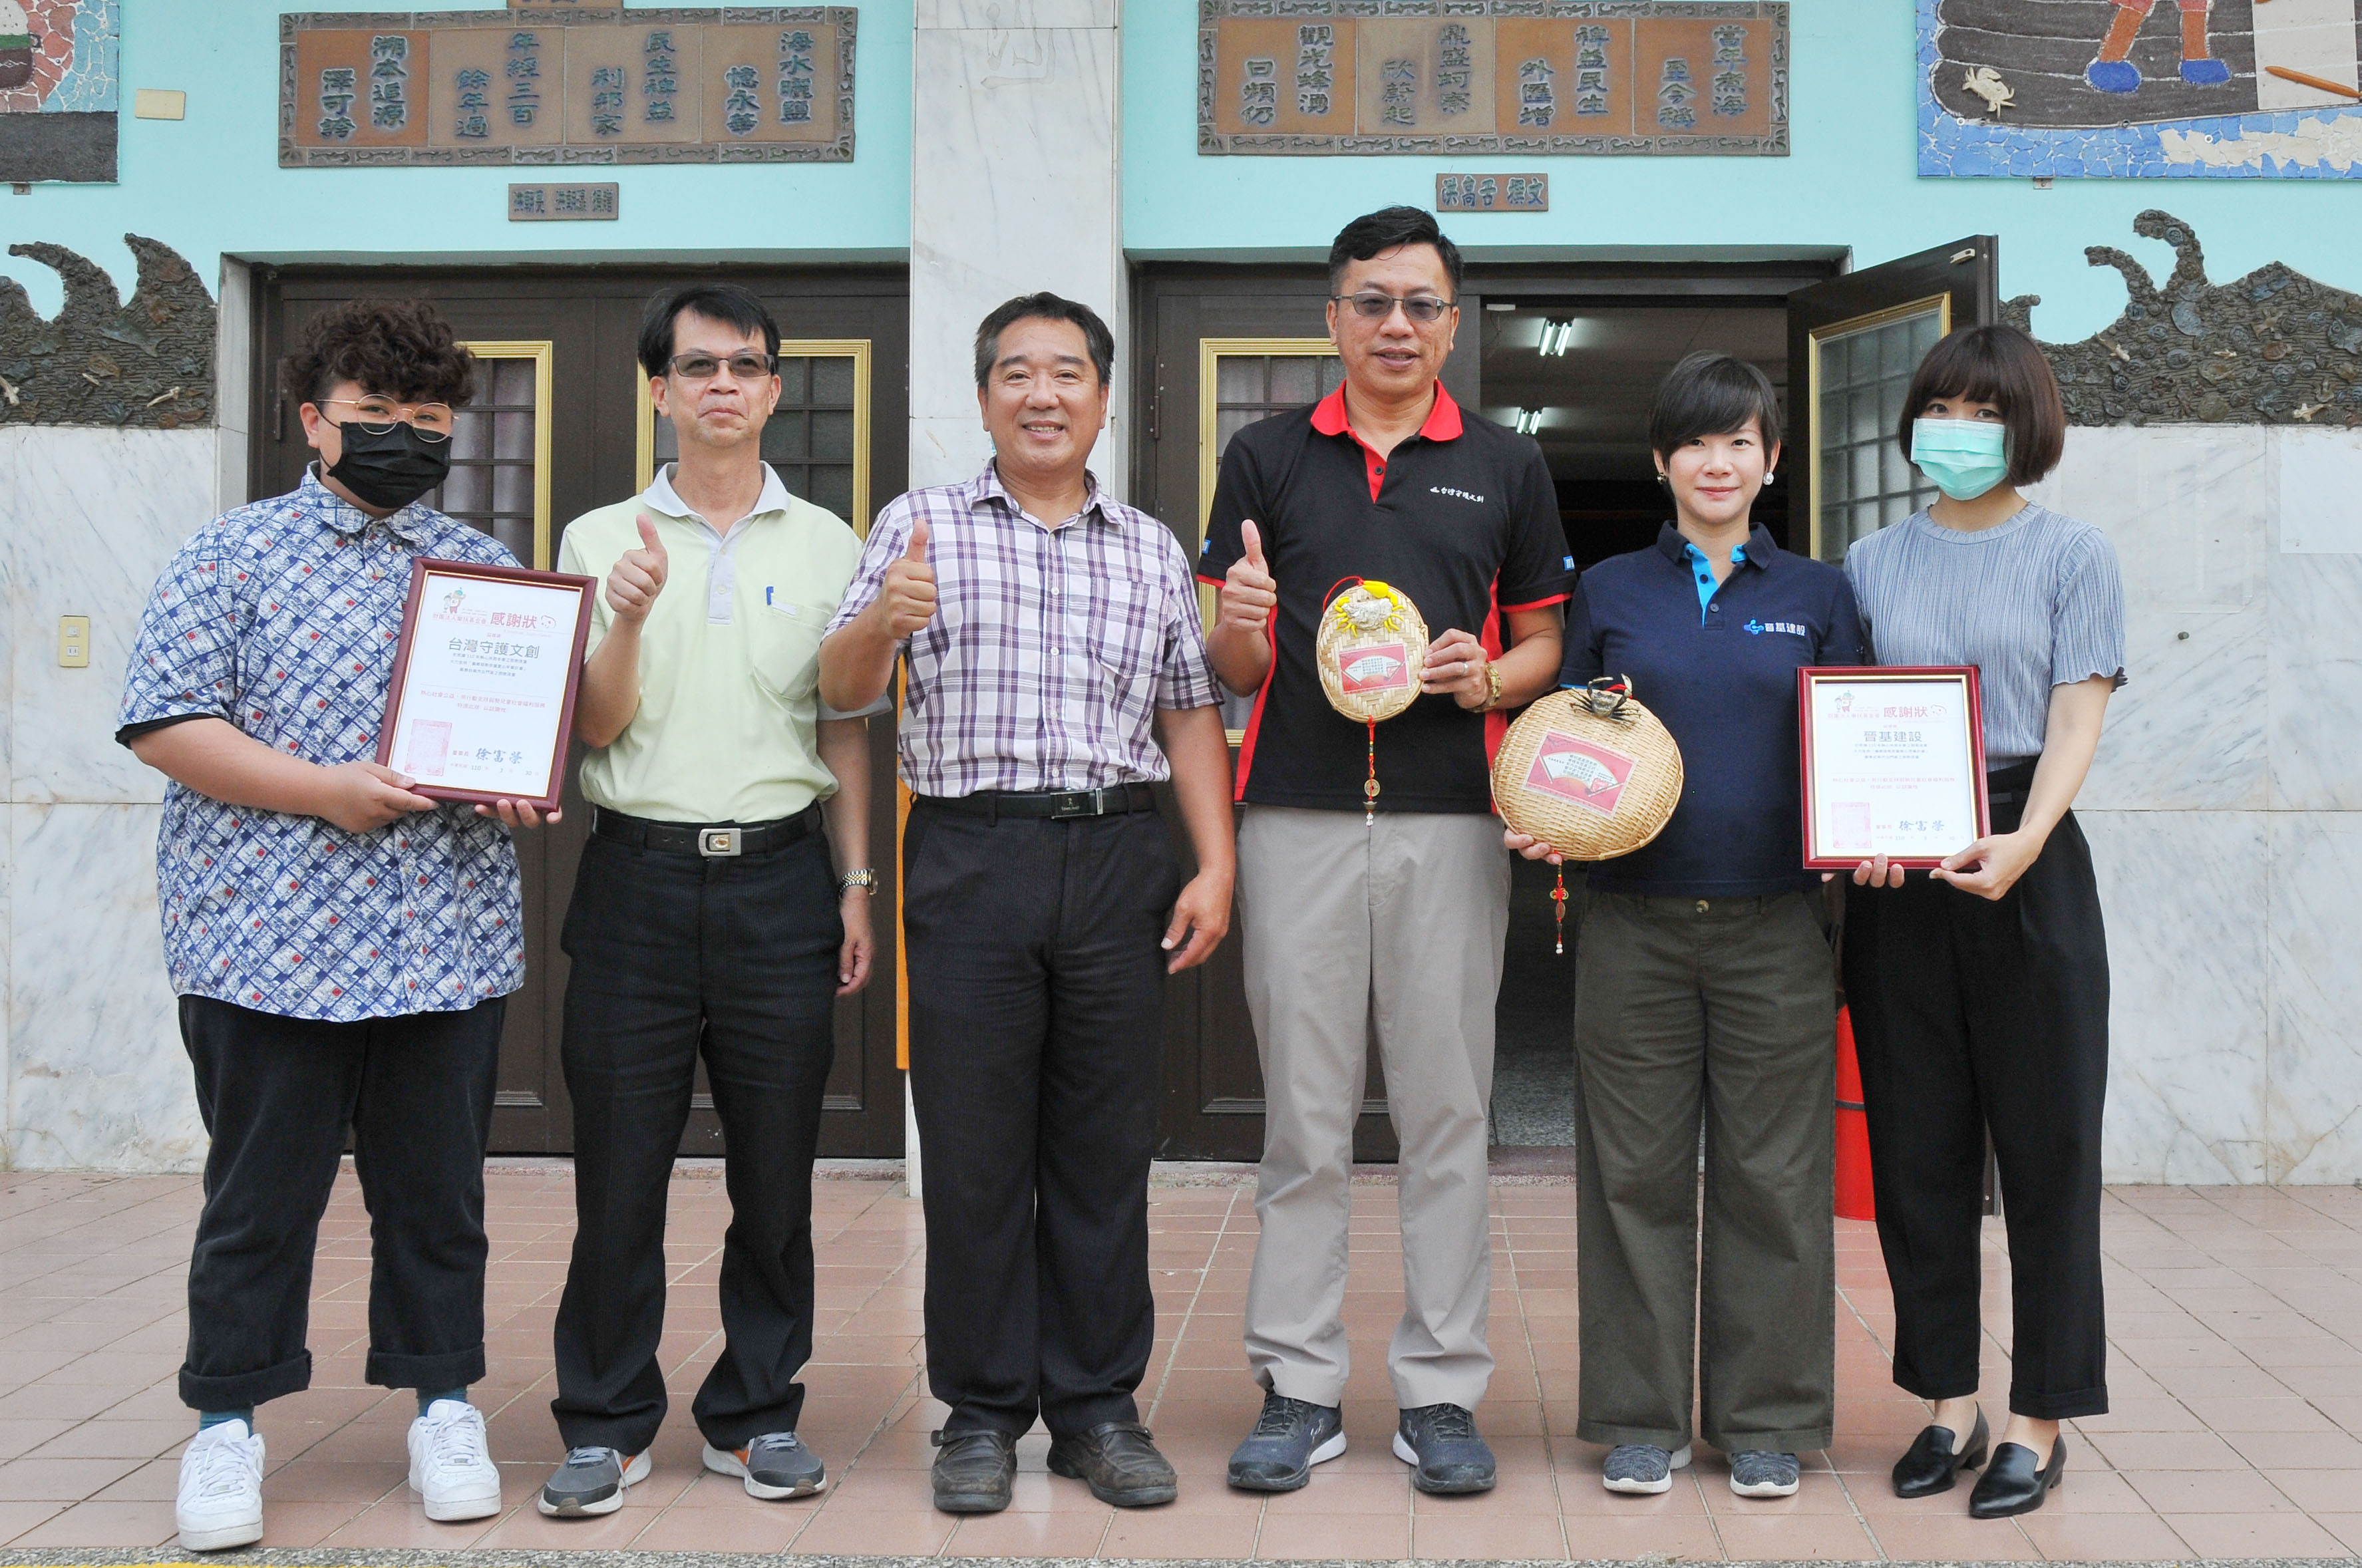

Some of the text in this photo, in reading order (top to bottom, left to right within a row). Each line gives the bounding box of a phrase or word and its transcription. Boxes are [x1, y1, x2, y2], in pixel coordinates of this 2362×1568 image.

[455, 69, 491, 138] 餘年過
[506, 33, 540, 124] 年經三百
[1381, 60, 1416, 126] 欣蔚起
[1519, 59, 1555, 127] 外匯增
[1659, 59, 1695, 128] 至今稱
[1713, 25, 1747, 116] 當年煮海
[448, 637, 540, 659] 台灣守護文創
[490, 611, 538, 629] 感謝狀
[1864, 731, 1922, 742] 晉基建設
[1884, 706, 1928, 718] 感謝狀
